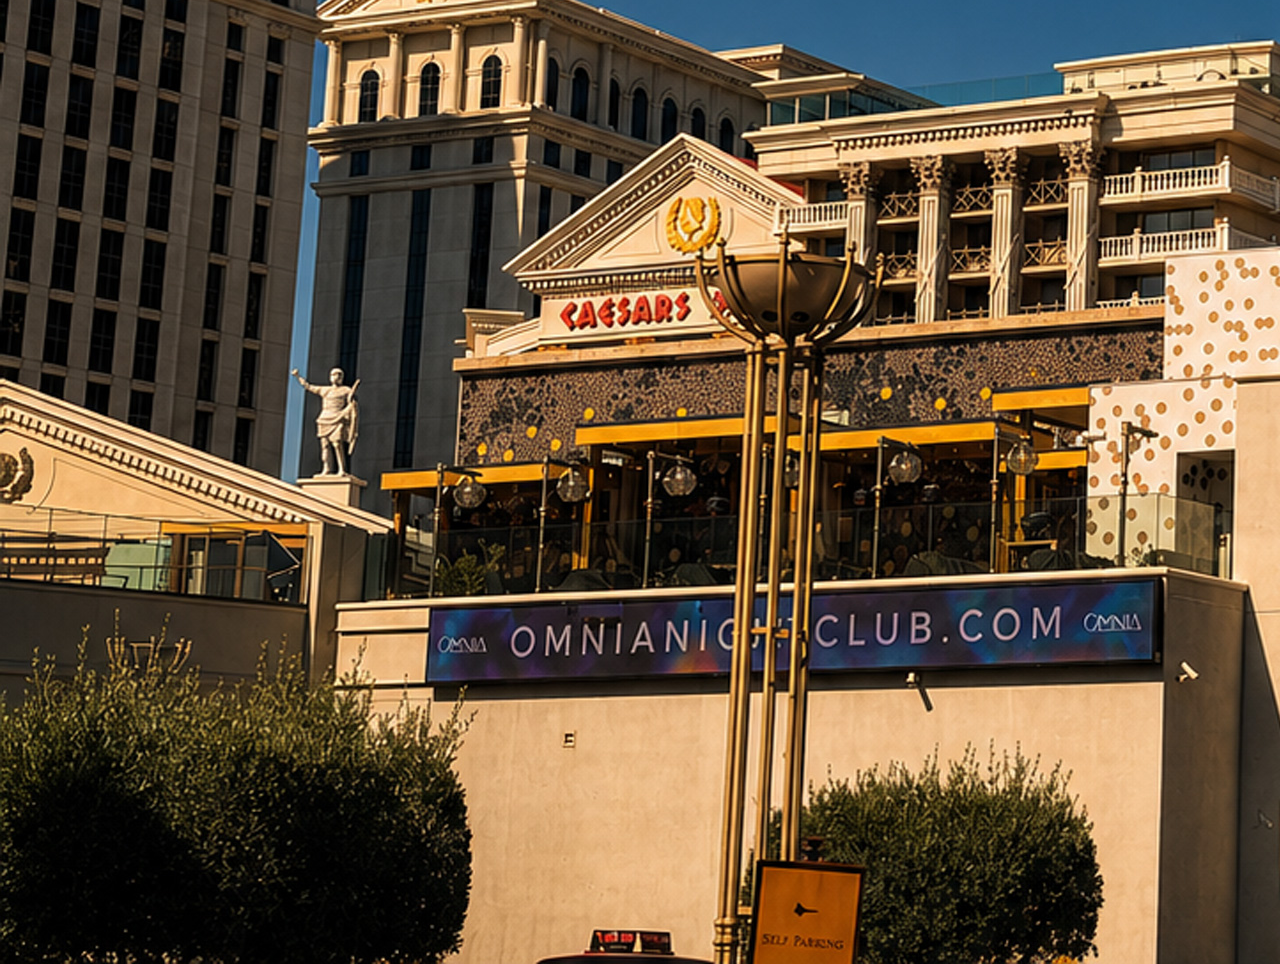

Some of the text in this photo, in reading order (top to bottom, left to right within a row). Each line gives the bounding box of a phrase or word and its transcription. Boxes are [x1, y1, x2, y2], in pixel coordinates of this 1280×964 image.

[560, 291, 691, 331] CAESARS
[511, 606, 1061, 658] OMNIANIGCLUB.COM
[1083, 612, 1142, 632] OMNIA
[438, 636, 487, 653] OMNIA
[762, 934, 844, 950] SELF PARKING
